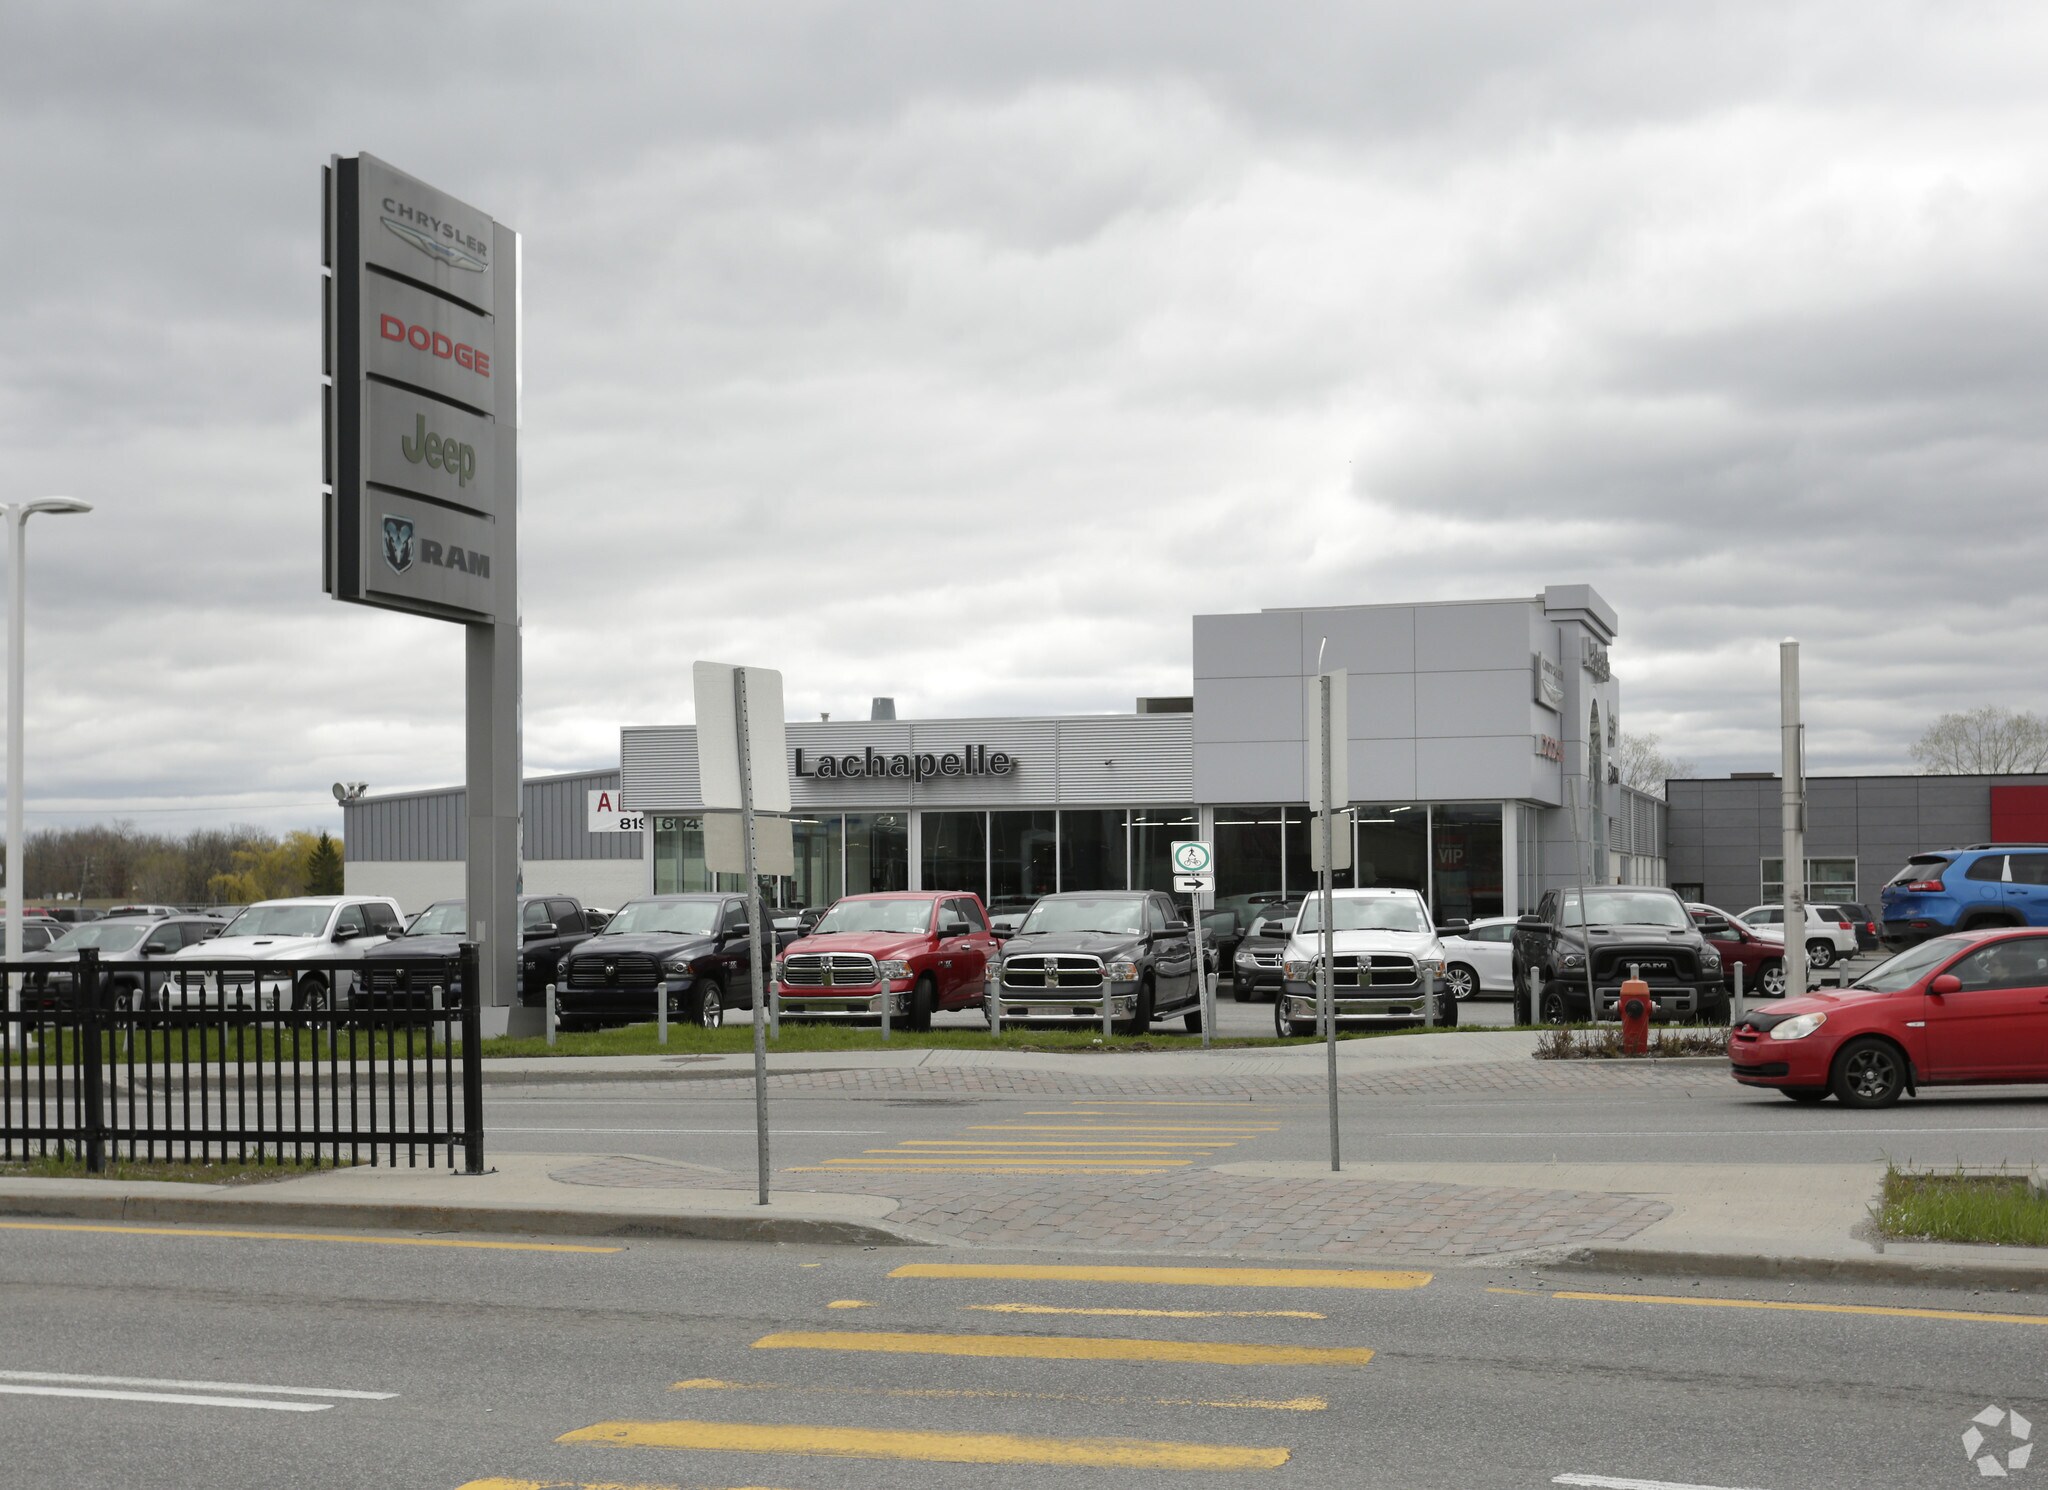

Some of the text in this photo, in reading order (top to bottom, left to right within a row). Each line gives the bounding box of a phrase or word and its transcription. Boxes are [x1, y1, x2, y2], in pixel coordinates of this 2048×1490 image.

[381, 197, 488, 257] CHRYSLER
[380, 313, 490, 378] DODGE
[401, 412, 476, 487] Jeep
[420, 537, 490, 579] RAM
[795, 745, 1011, 784] Lachapelle
[1438, 849, 1463, 864] VIP
